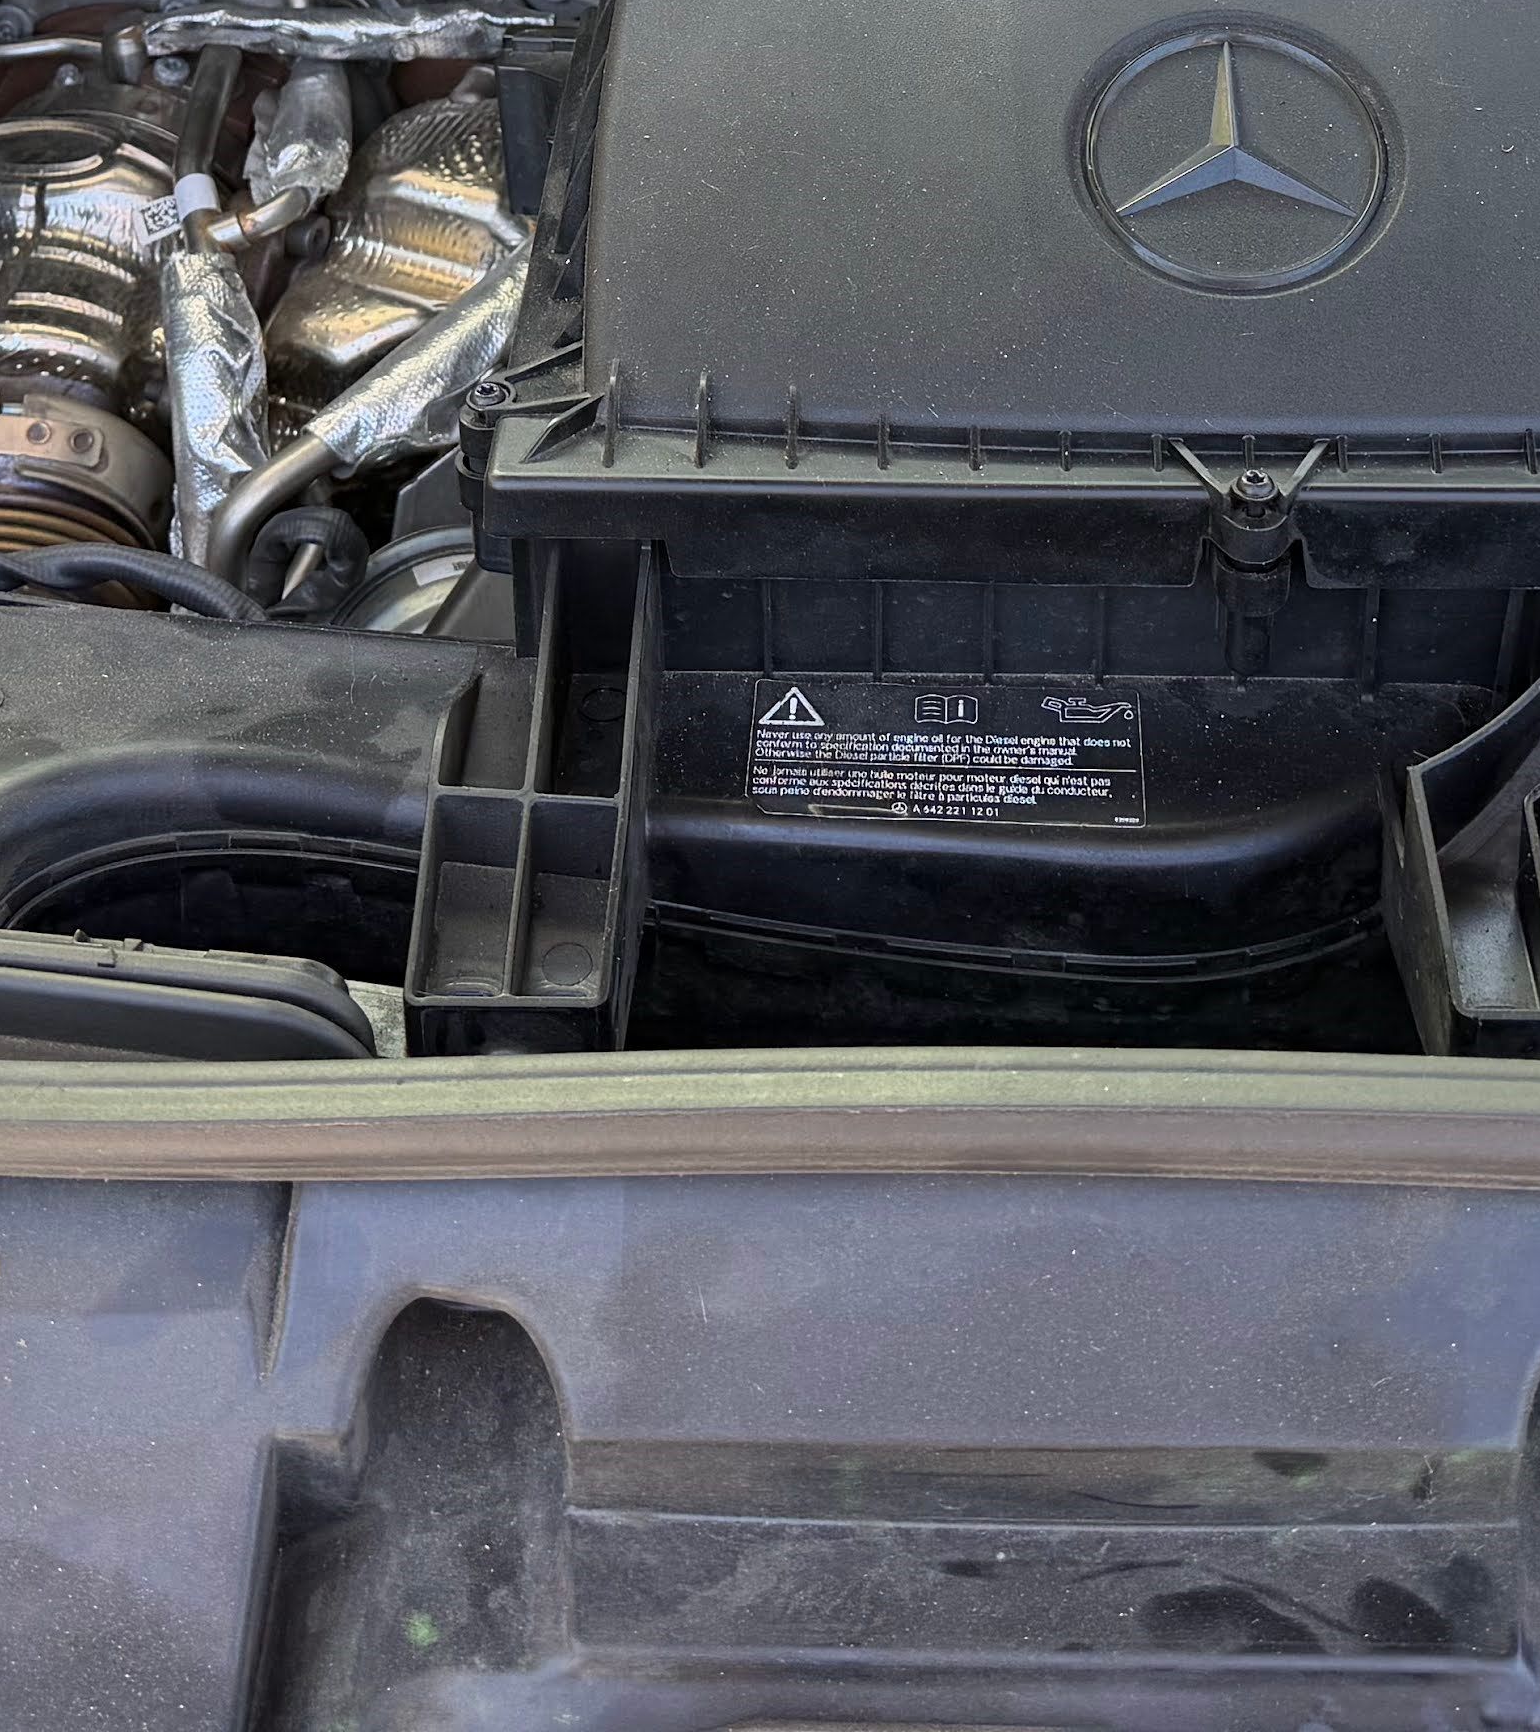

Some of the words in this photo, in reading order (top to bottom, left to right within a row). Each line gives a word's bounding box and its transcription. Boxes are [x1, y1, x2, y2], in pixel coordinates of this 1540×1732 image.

[757, 729, 789, 739] Never
[792, 731, 811, 739] use
[814, 732, 833, 741] any
[836, 732, 875, 741] amount
[879, 732, 890, 741] of
[894, 735, 928, 744] engine
[931, 734, 943, 742] oil
[947, 734, 961, 743] for
[965, 734, 983, 744] the
[986, 735, 1018, 745] Diesel
[1021, 736, 1055, 746] engine
[1059, 737, 1080, 746] that
[1084, 738, 1110, 747] does
[1112, 739, 1131, 748] not
[756, 740, 802, 748] conform
[805, 741, 817, 749] to
[891, 743, 959, 753] documented
[973, 745, 990, 754] the
[756, 749, 811, 758] Otherwise
[815, 750, 832, 759] the
[835, 750, 868, 761] Diesel
[914, 752, 938, 762] filter
[942, 753, 970, 764] (DPF)
[973, 754, 1001, 764] could
[1004, 755, 1018, 764] be
[913, 805, 921, 813] A
[924, 805, 943, 814] 642
[946, 807, 966, 815] 221
[972, 807, 984, 815] 12
[986, 808, 999, 816] 01
